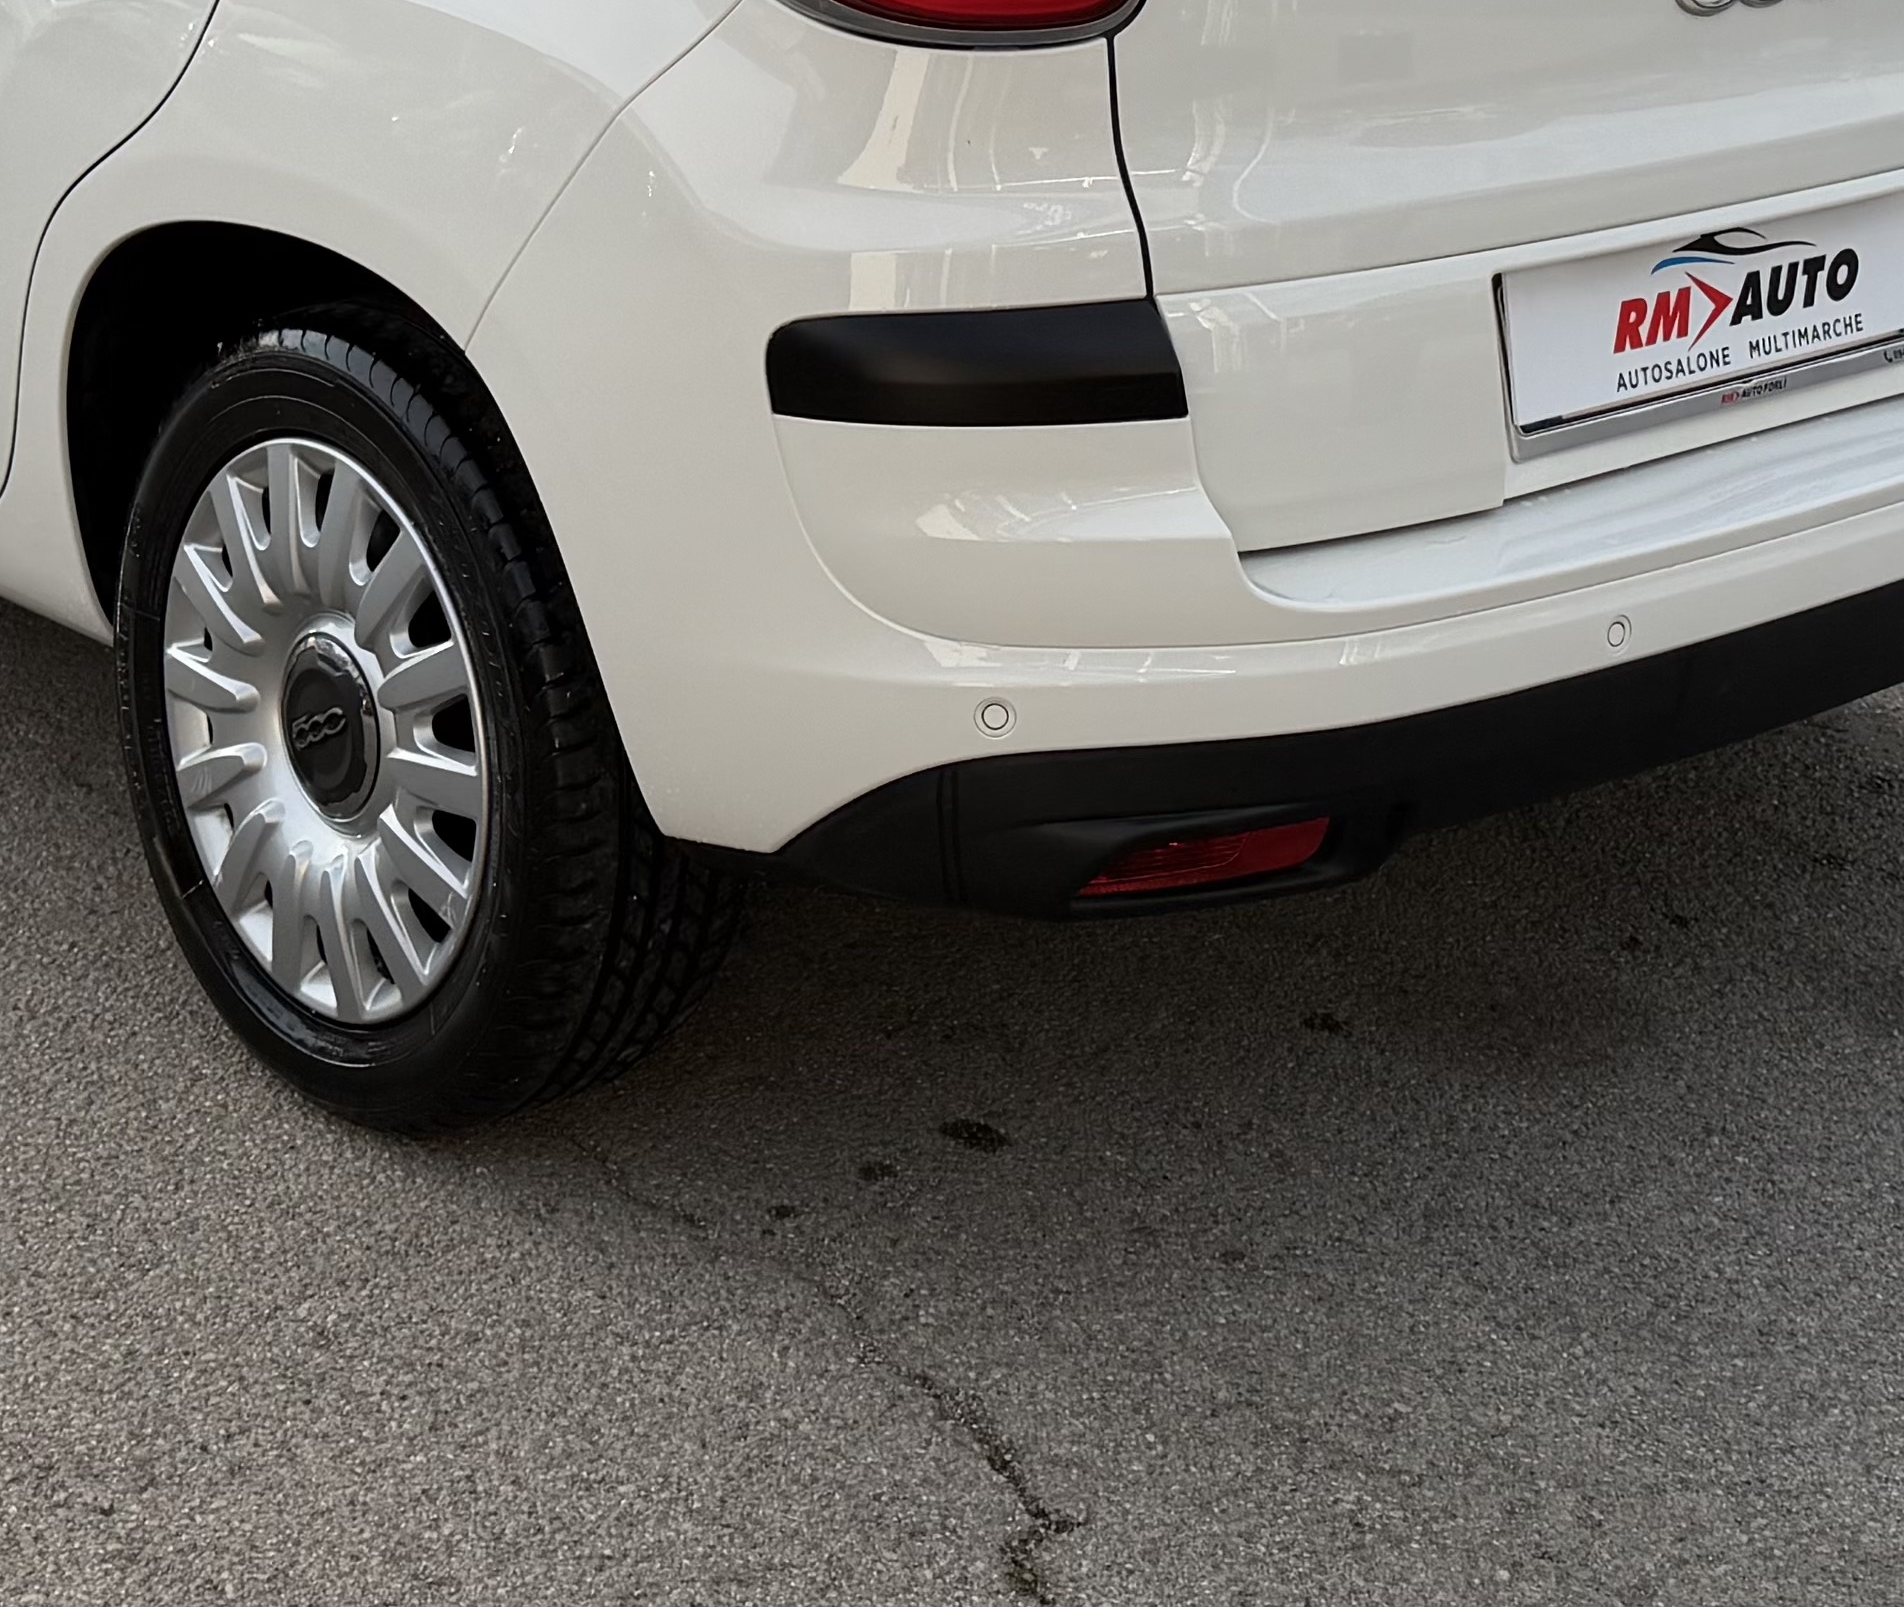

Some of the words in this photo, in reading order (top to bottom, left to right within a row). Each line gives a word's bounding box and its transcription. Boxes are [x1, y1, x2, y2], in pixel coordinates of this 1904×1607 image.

[1729, 248, 1859, 327] AUTO
[1616, 347, 1731, 392] AUTOSALONE
[1748, 313, 1864, 359] MULTIMARCHE
[292, 707, 346, 751] 500
